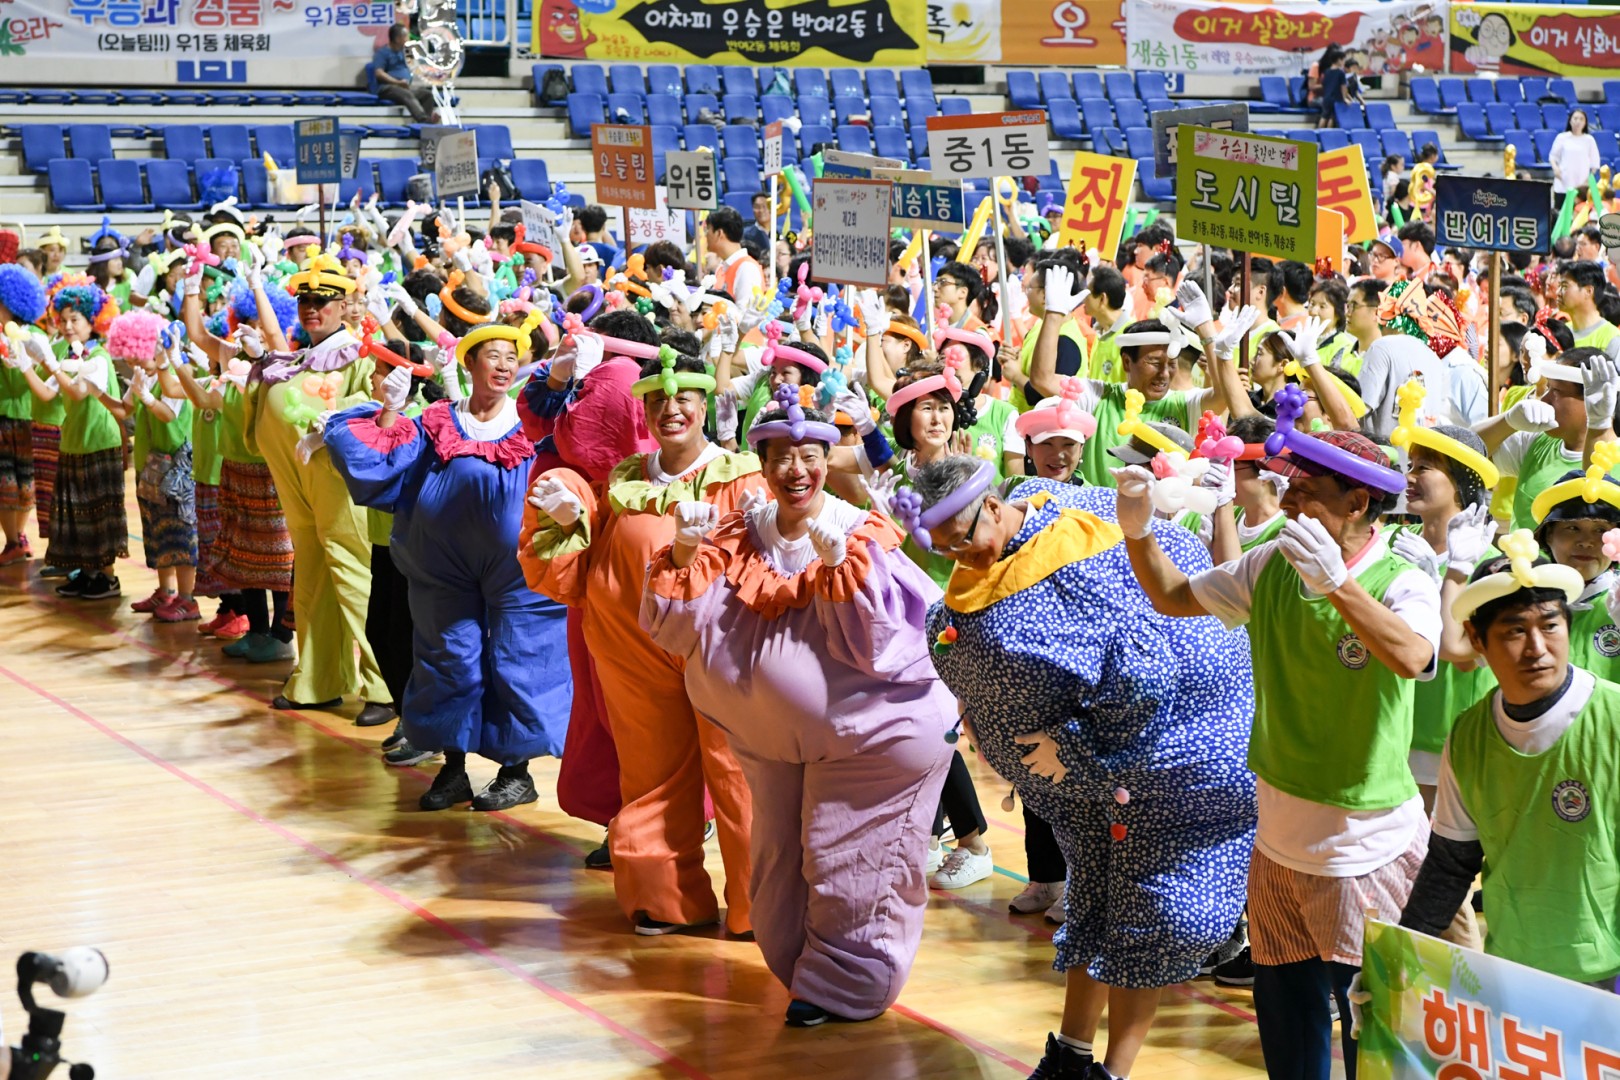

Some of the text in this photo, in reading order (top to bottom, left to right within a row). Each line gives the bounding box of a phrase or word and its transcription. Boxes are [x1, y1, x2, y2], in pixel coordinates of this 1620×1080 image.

[9, 17, 63, 43] 오라~
[305, 3, 394, 27] 우1동으로!
[645, 3, 712, 29] 어차피
[722, 8, 783, 38] 우승은
[792, 9, 867, 38] 반여2동
[1193, 11, 1334, 45] 이거 실화냐?
[98, 33, 271, 52] (오늘팀!!) 우1동 체육회
[1530, 24, 1620, 58] 이거 실화
[300, 141, 335, 165] 내일팀
[600, 151, 647, 182] 오늘팀
[943, 132, 1034, 173] 중1동
[1220, 138, 1249, 160] 우승!
[1253, 143, 1276, 163] 꽃길만
[669, 164, 713, 201] 우1동
[1190, 168, 1300, 226] 도시팀
[842, 210, 857, 228] 제2회
[892, 187, 951, 221] 재송1동
[1067, 162, 1123, 253] 좌
[629, 218, 666, 239] 송정동
[1248, 229, 1273, 249] 반여1동,
[1273, 233, 1296, 253] 재송2동
[1444, 210, 1538, 249] 반여1동
